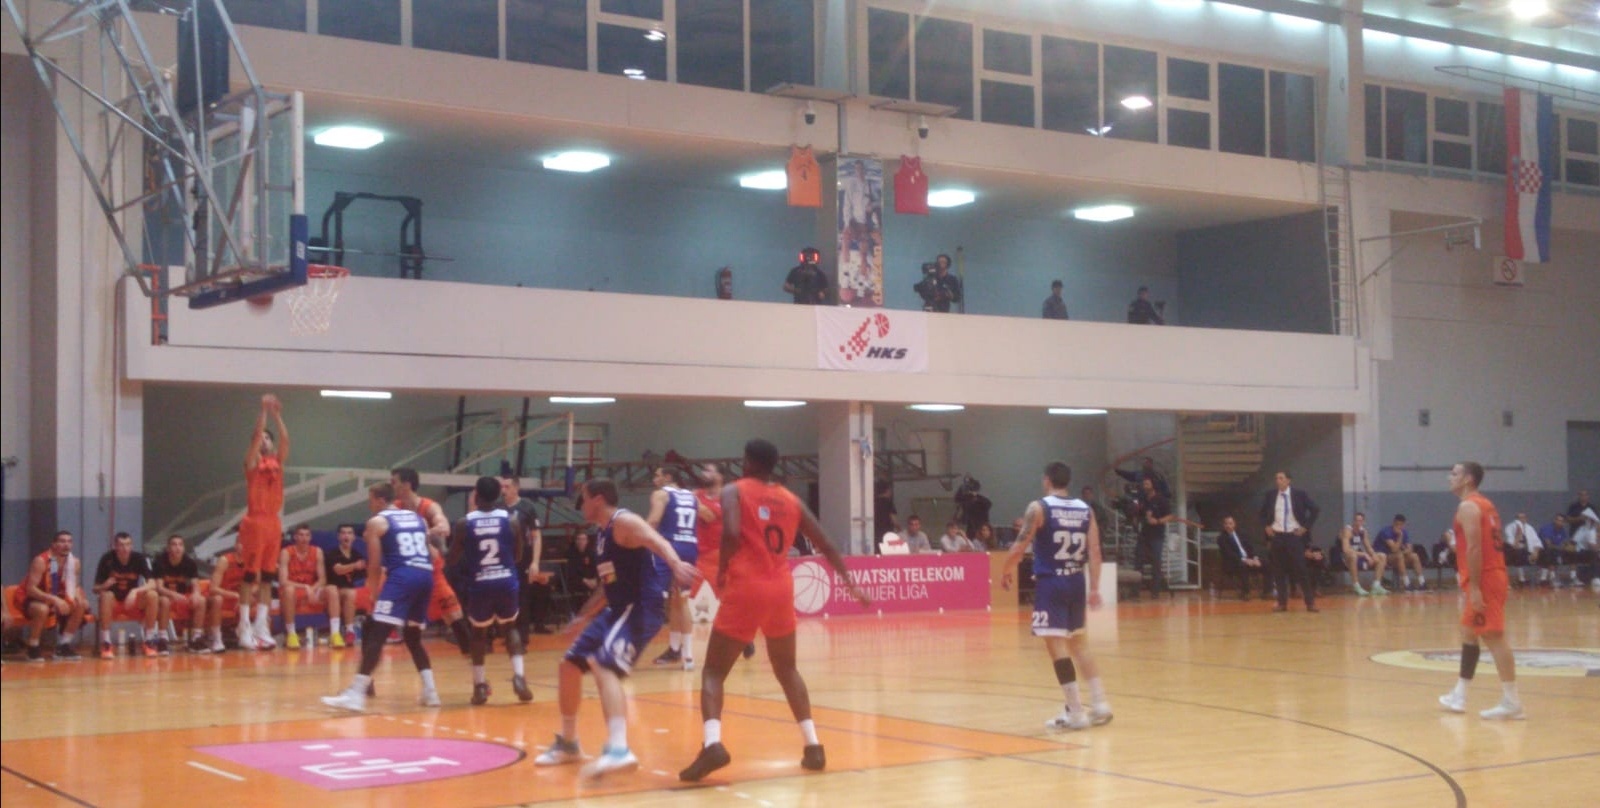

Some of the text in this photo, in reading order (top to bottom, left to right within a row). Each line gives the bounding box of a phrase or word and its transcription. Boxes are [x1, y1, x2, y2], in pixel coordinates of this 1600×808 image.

[866, 346, 908, 359] HKS
[675, 507, 696, 528] 17
[396, 532, 428, 557] 88
[764, 525, 784, 554] 0
[1053, 530, 1086, 560] 22
[479, 539, 500, 565] 2
[903, 566, 964, 582] TELEKOM
[900, 584, 928, 600] LIGA
[1032, 610, 1049, 627] 22
